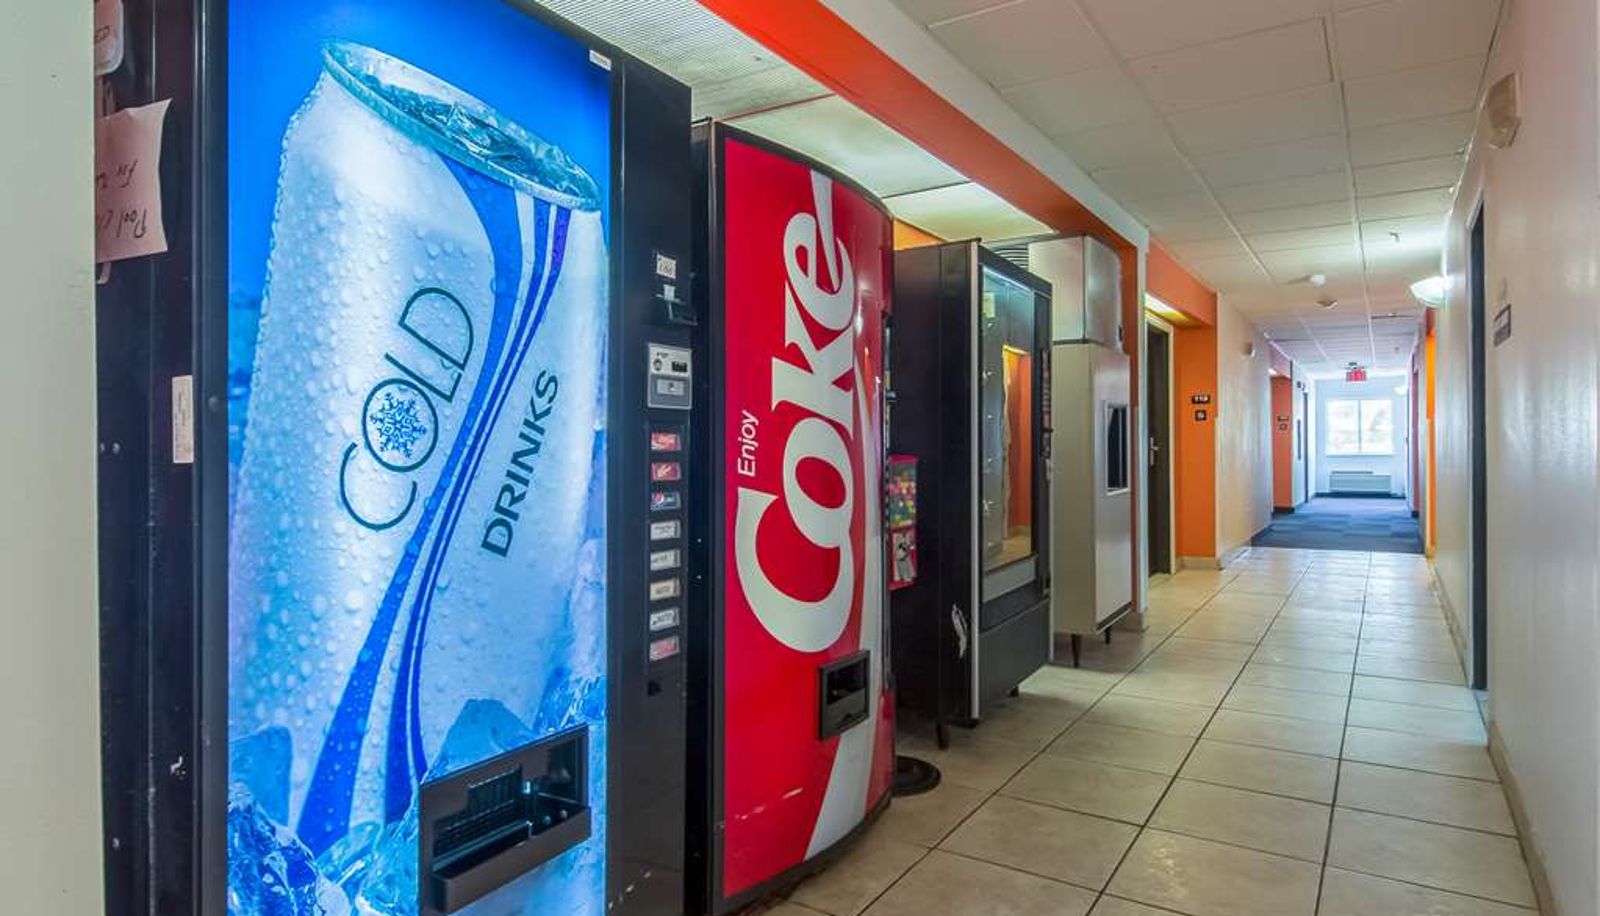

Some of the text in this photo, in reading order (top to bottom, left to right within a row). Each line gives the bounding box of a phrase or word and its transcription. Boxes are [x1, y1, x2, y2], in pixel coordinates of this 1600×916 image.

[338, 286, 475, 532] COLD
[480, 369, 559, 557] DRINKS
[734, 170, 856, 653] Coke
[737, 409, 760, 477] Enjoy
